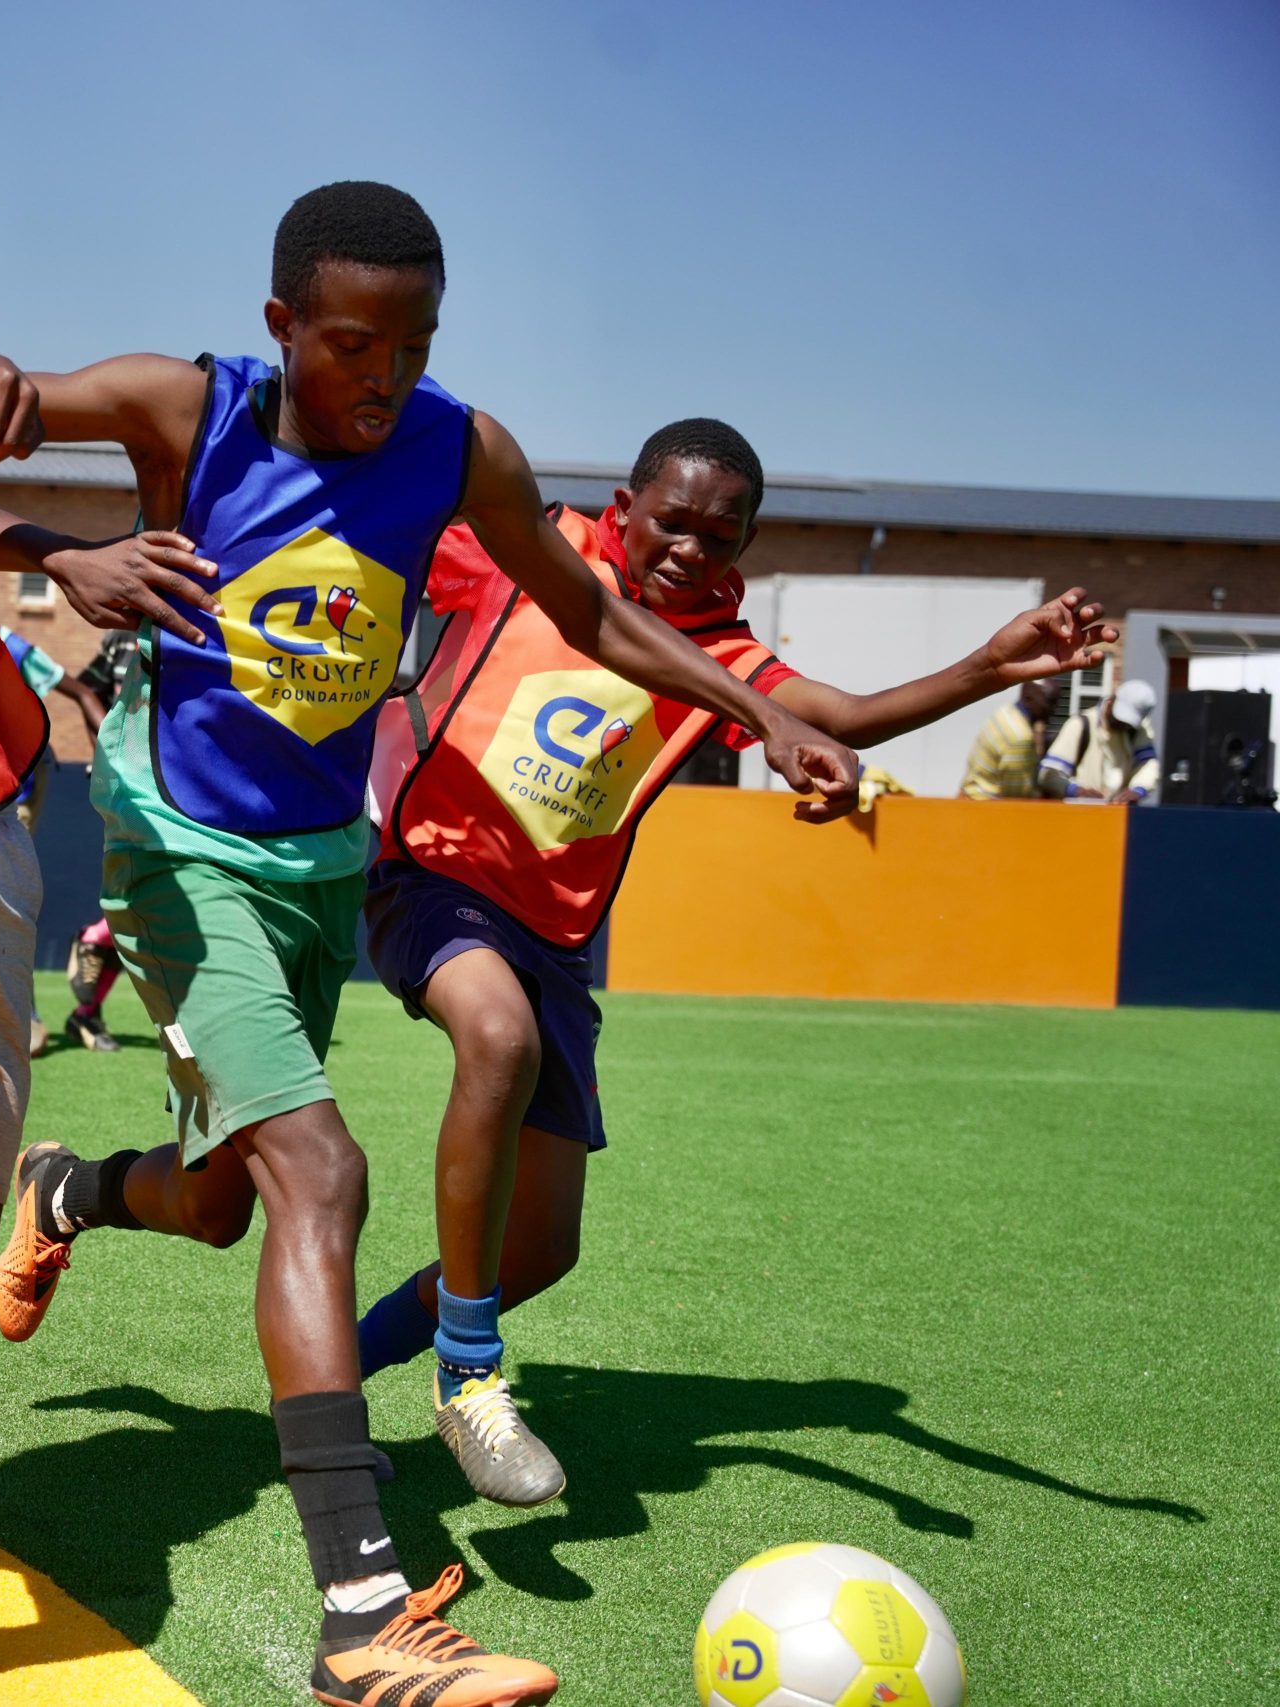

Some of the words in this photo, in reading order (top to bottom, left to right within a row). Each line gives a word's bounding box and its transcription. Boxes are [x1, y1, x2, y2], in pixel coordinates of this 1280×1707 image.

[266, 656, 381, 684] CRUYFF
[272, 688, 371, 703] FOUNDATION
[508, 782, 594, 828] FOUNDATION
[513, 756, 608, 812] CRUYFF
[864, 1587, 894, 1661] CRUYFF
